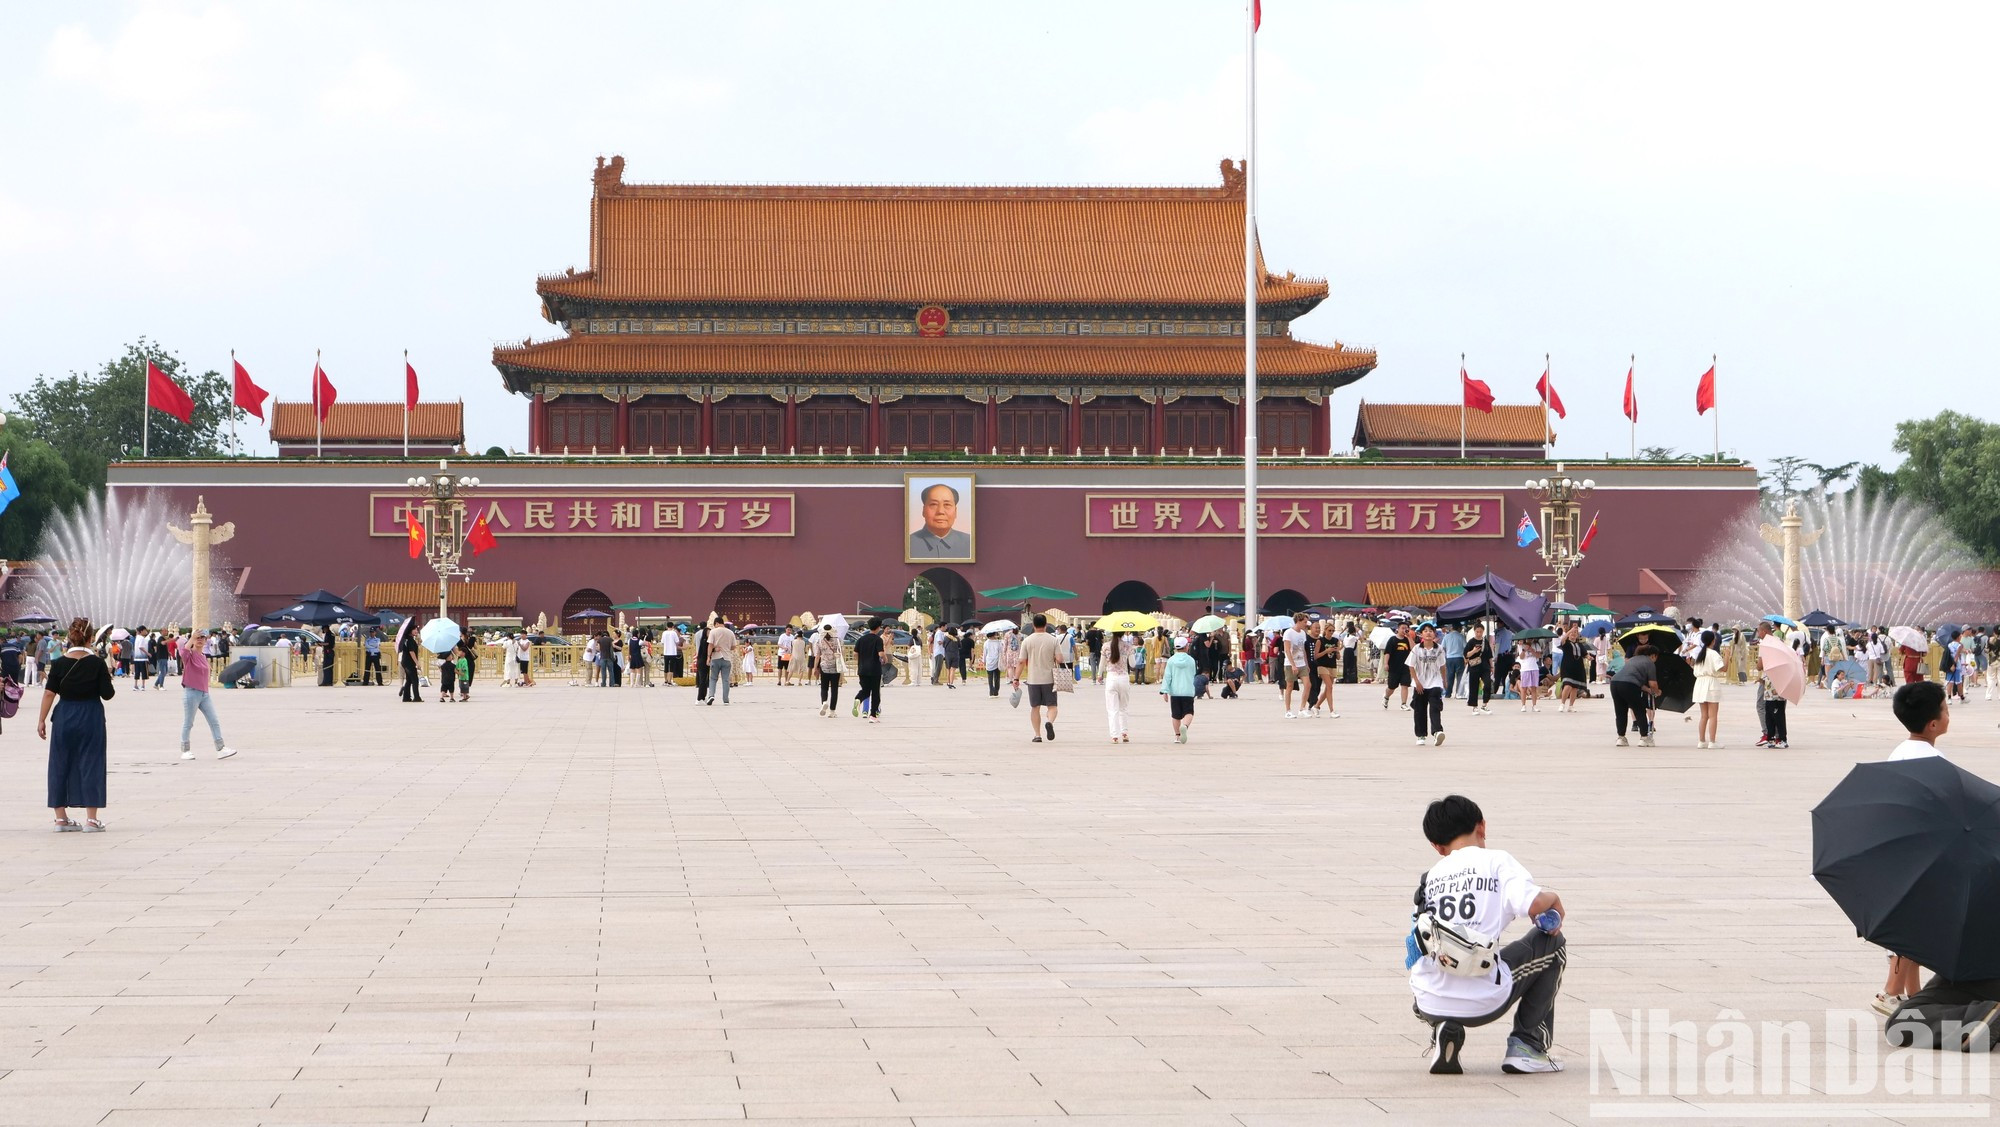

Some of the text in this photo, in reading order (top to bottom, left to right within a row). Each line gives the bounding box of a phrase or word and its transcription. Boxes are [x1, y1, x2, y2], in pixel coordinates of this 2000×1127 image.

[393, 501, 772, 530] 中人民共和国万岁
[1109, 502, 1483, 531] 世界人民大团结万岁
[1449, 877, 1474, 893] PLAY
[1476, 877, 1499, 893] DICE
